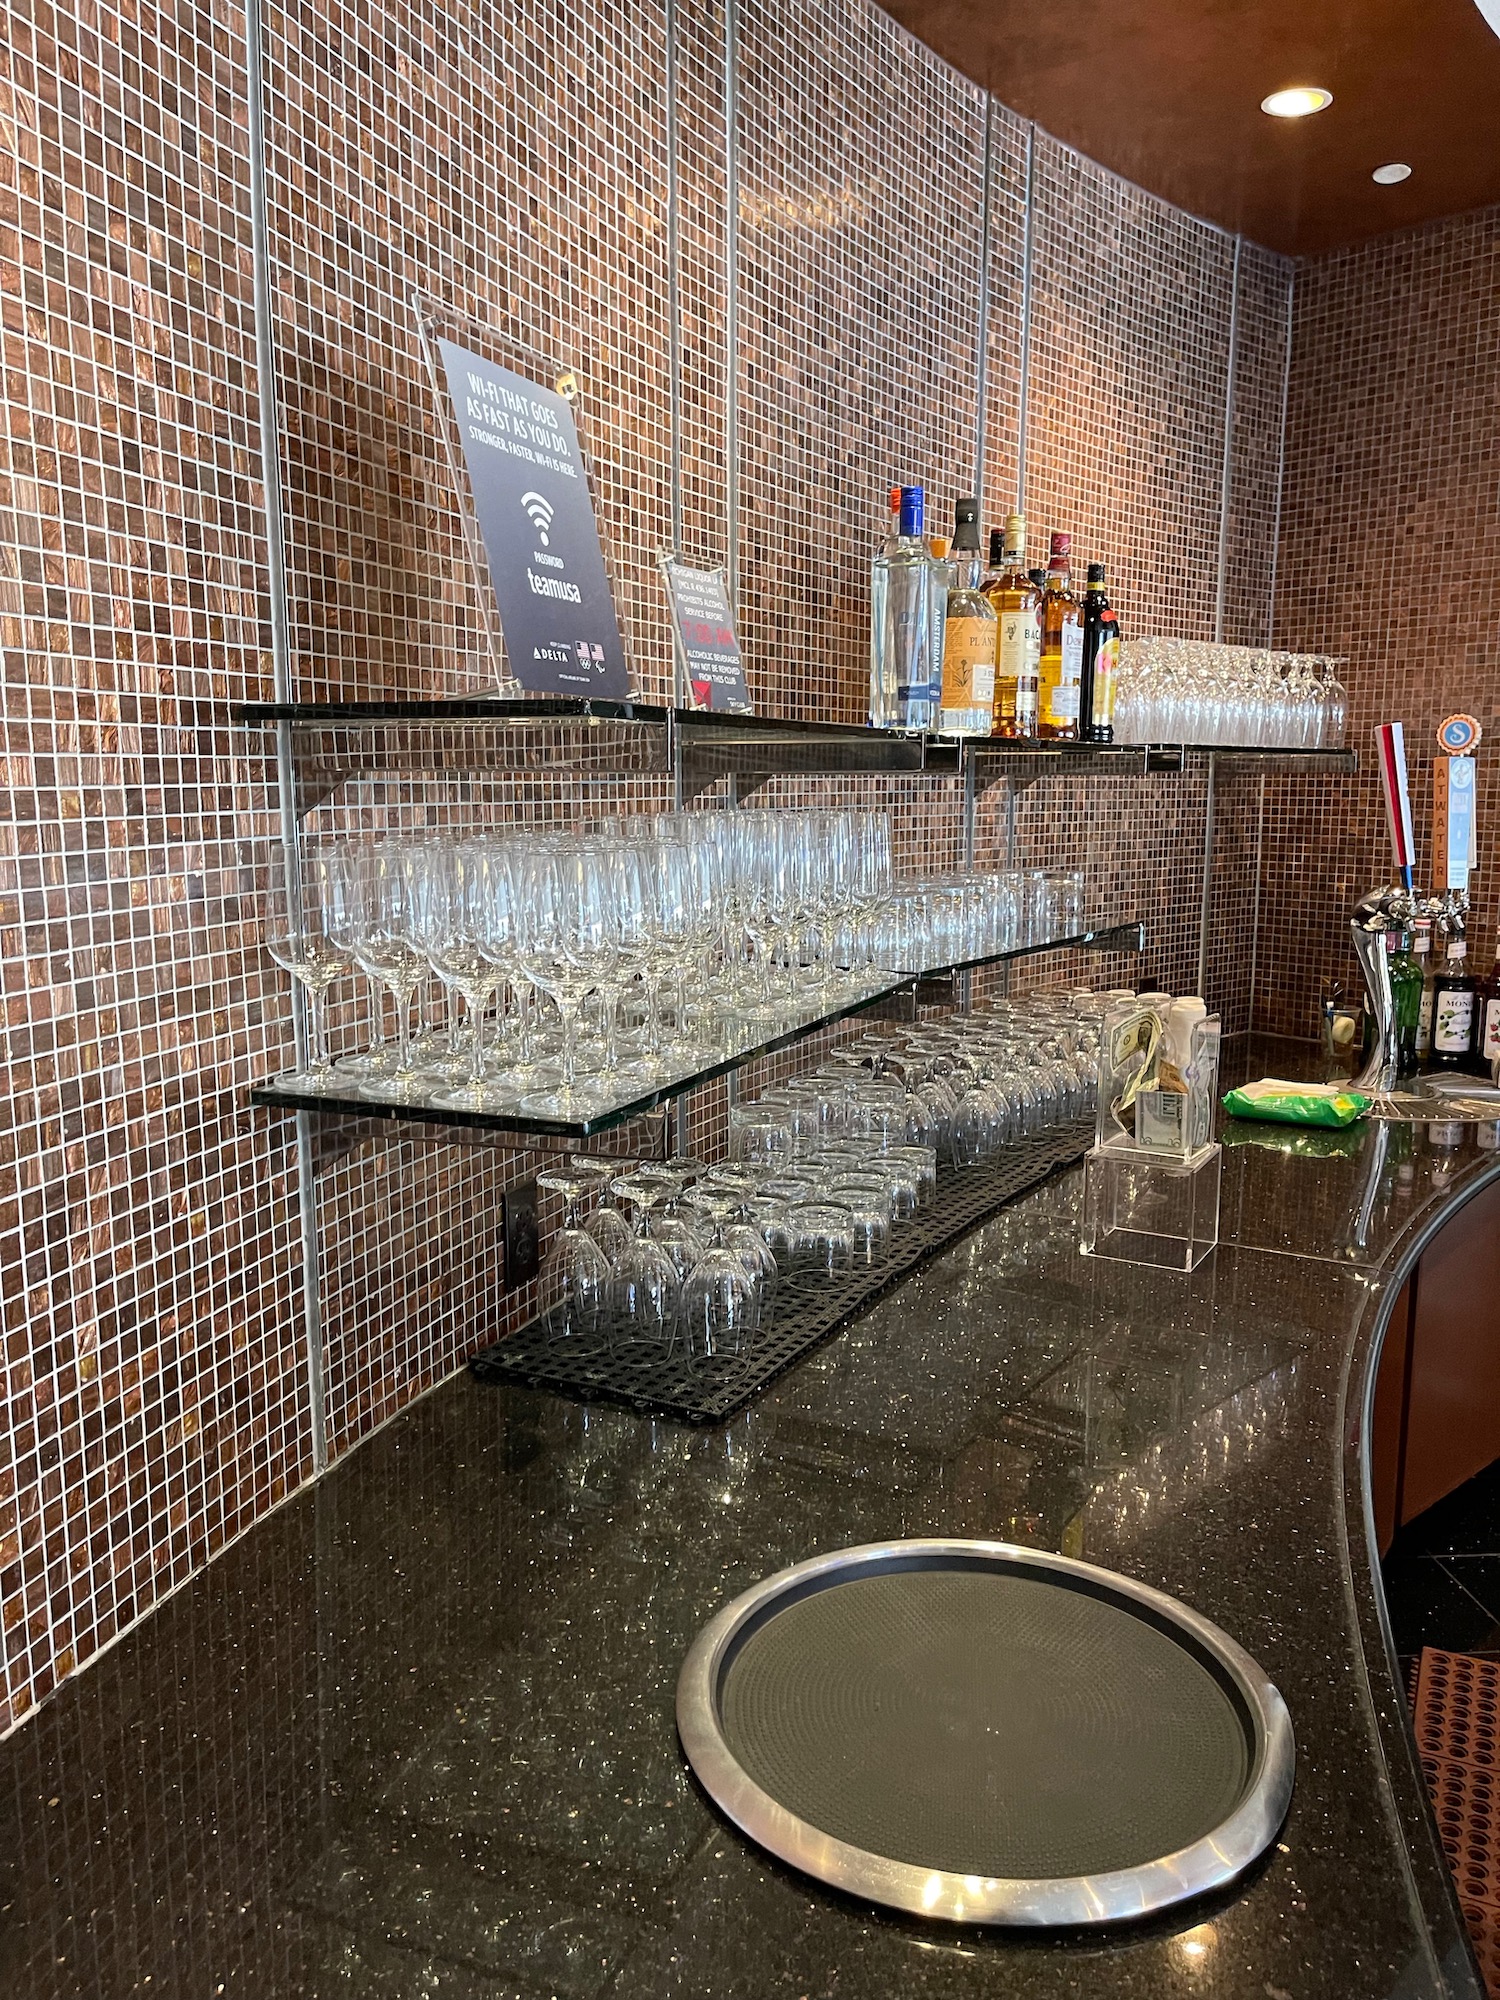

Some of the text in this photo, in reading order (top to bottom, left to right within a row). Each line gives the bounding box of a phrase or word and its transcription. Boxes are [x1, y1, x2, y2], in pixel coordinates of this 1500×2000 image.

[467, 371, 558, 429] WI-FI THAT GOES
[466, 396, 571, 457] AS FAST AS YOU DO.
[468, 425, 578, 478] STRONGER, FASTER, WI-FI IS HERE.
[533, 550, 564, 570] PASSWORD
[527, 567, 582, 604] teamusa
[676, 592, 725, 610] PROHIBITS ALCOHOL
[684, 606, 724, 622] SERVICE BEFORE
[932, 607, 941, 672] AMSTERDAM
[541, 648, 568, 663] DELTA
[687, 649, 740, 665] ALCOHOLIC BEVERAGES
[689, 661, 741, 676] MAY NOT BE REMOVED
[698, 672, 737, 685] FROM THIS CLUB
[1449, 723, 1466, 744] S
[1435, 767, 1447, 877] ATWATER
